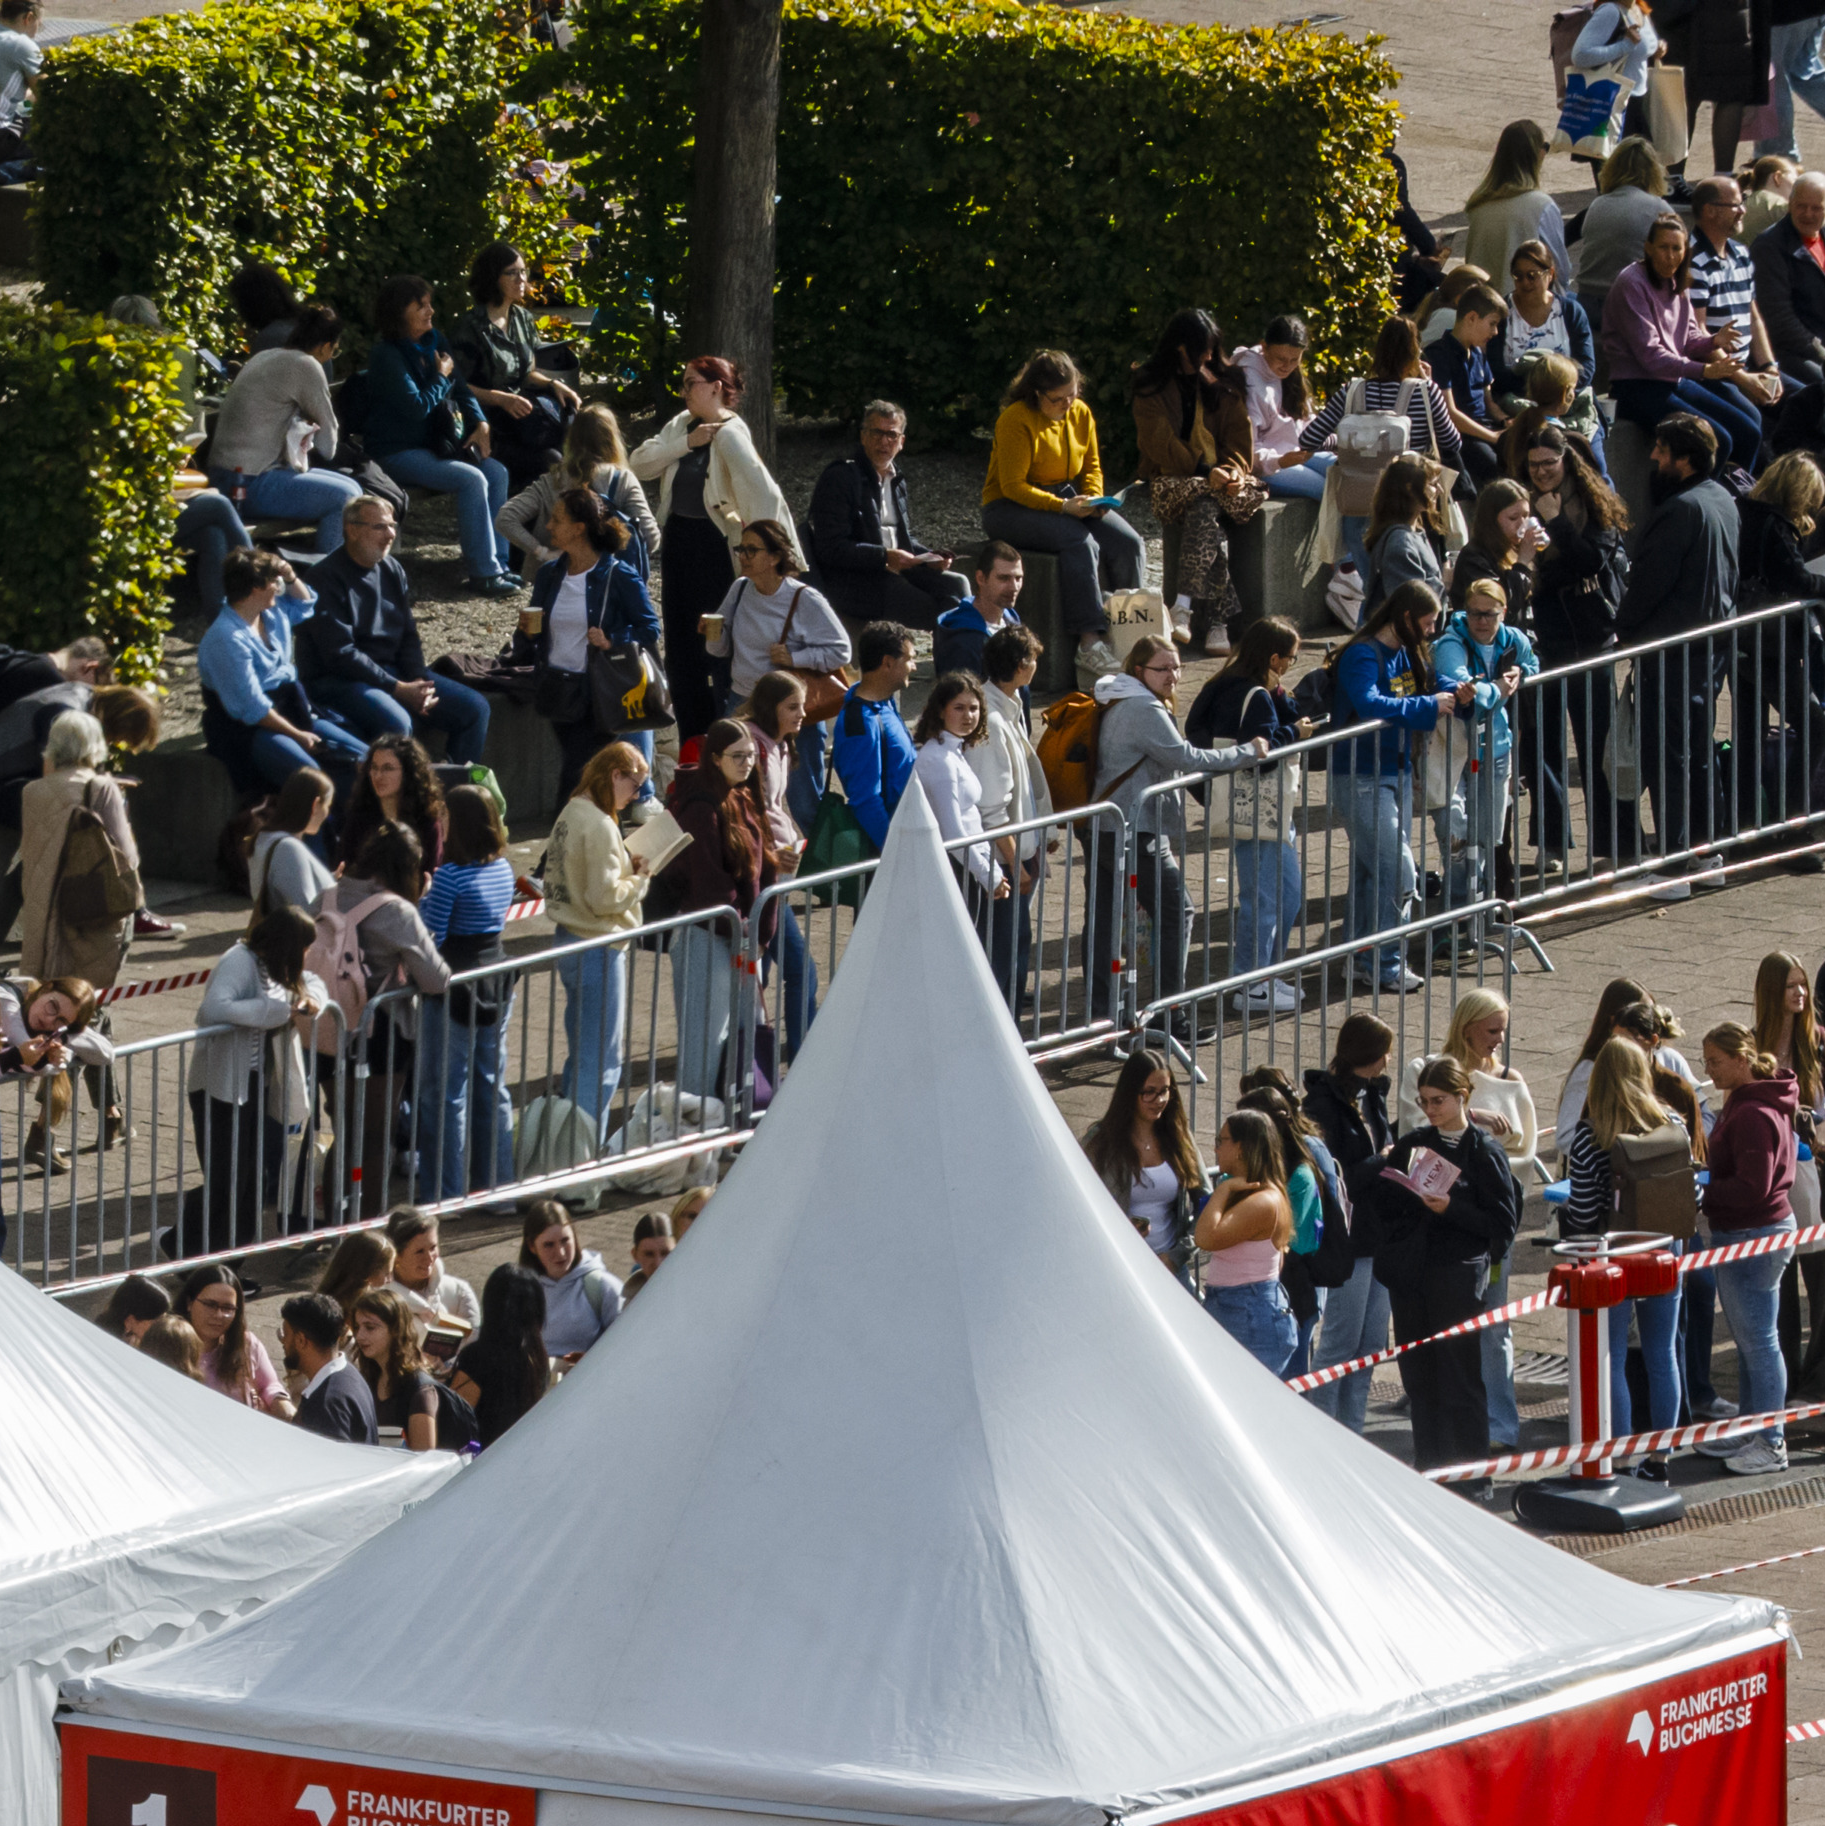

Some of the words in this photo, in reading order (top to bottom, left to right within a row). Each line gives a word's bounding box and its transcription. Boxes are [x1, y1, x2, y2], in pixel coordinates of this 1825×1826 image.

[1423, 1160, 1444, 1189] NEW
[1660, 1672, 1768, 1726] FRANKFURTER
[1659, 1702, 1752, 1753] BUCHMESSE
